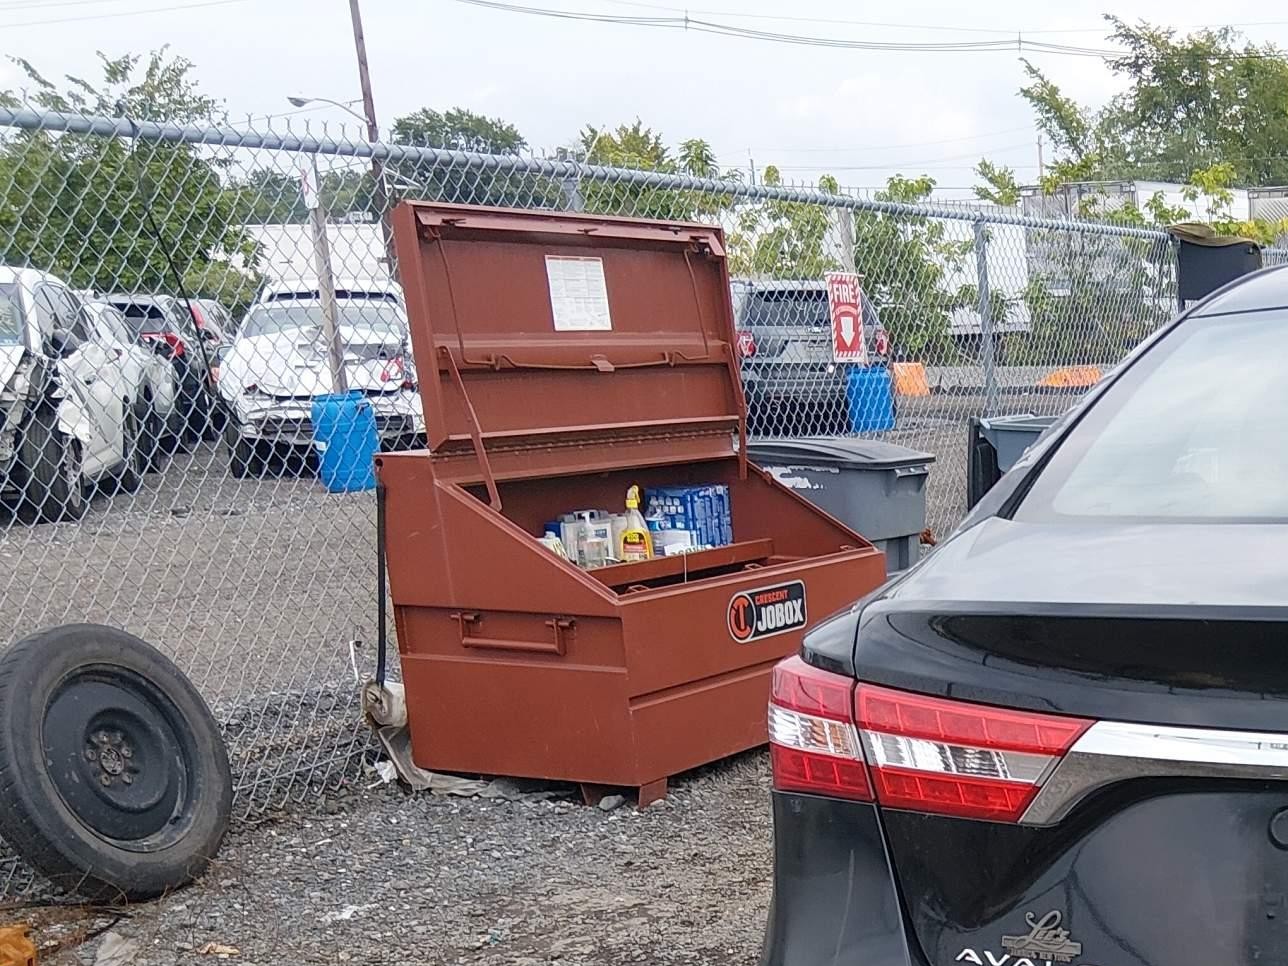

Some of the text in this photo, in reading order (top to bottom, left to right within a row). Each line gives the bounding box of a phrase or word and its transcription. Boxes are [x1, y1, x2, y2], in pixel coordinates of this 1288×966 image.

[833, 283, 856, 303] FIRE
[755, 590, 788, 605] CRESCENT
[757, 599, 803, 632] JOBOX
